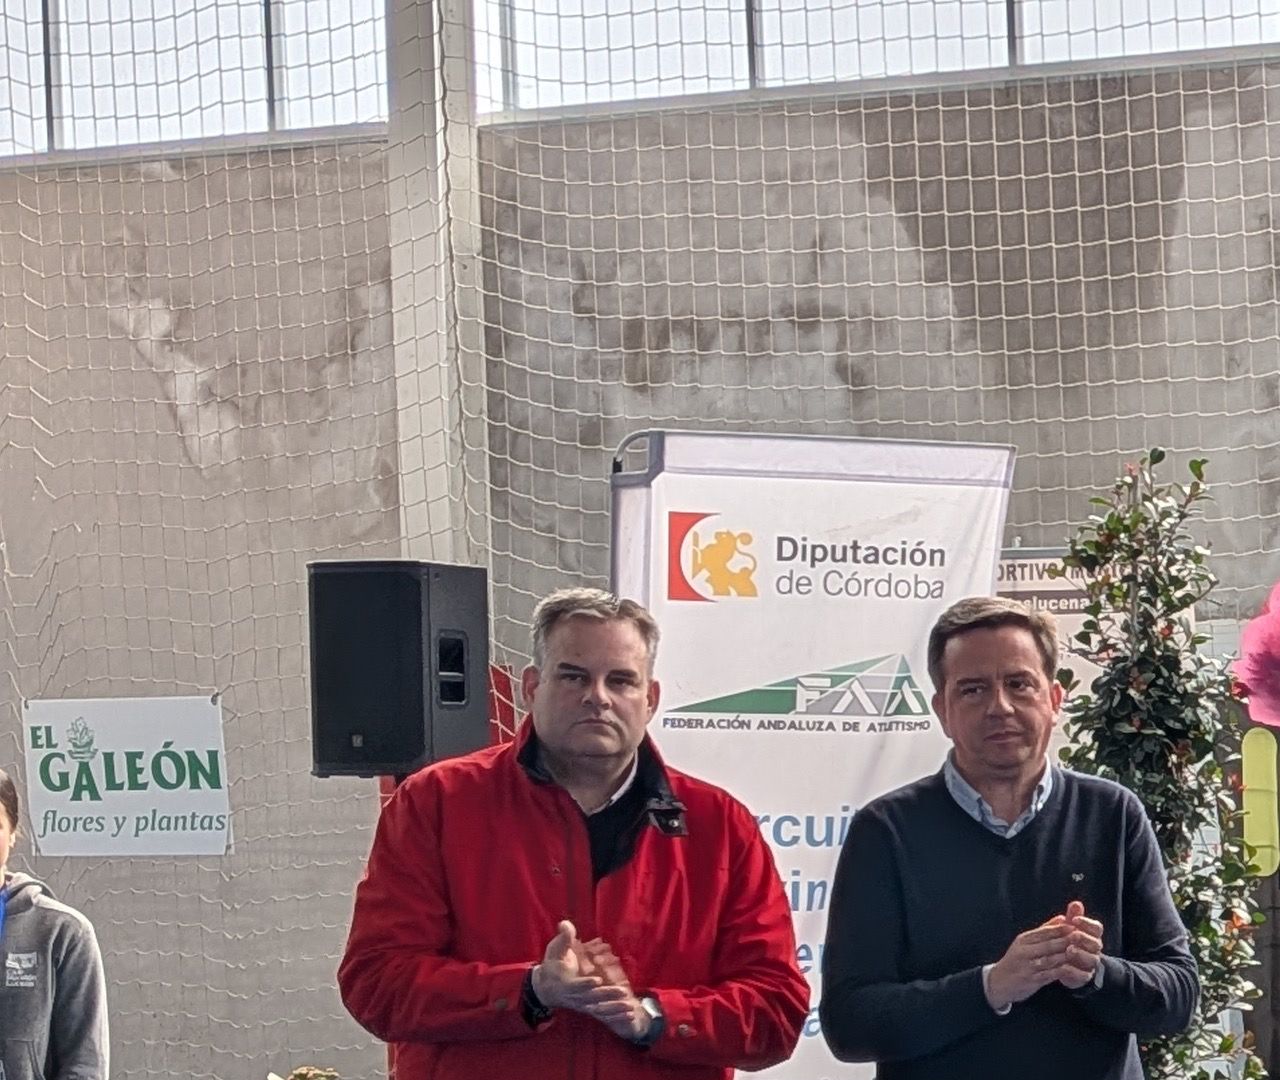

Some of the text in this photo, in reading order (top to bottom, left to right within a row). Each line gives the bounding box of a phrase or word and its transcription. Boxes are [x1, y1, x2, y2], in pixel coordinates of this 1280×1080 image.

[776, 536, 946, 570] Diputación
[776, 571, 945, 599] de Córdoba
[30, 726, 58, 749] EL
[663, 714, 931, 733] FEDERACIÓN ANDALUZA DE ATLETISMO
[39, 741, 222, 801] GALEÓN
[38, 809, 226, 838] flores y plantas
